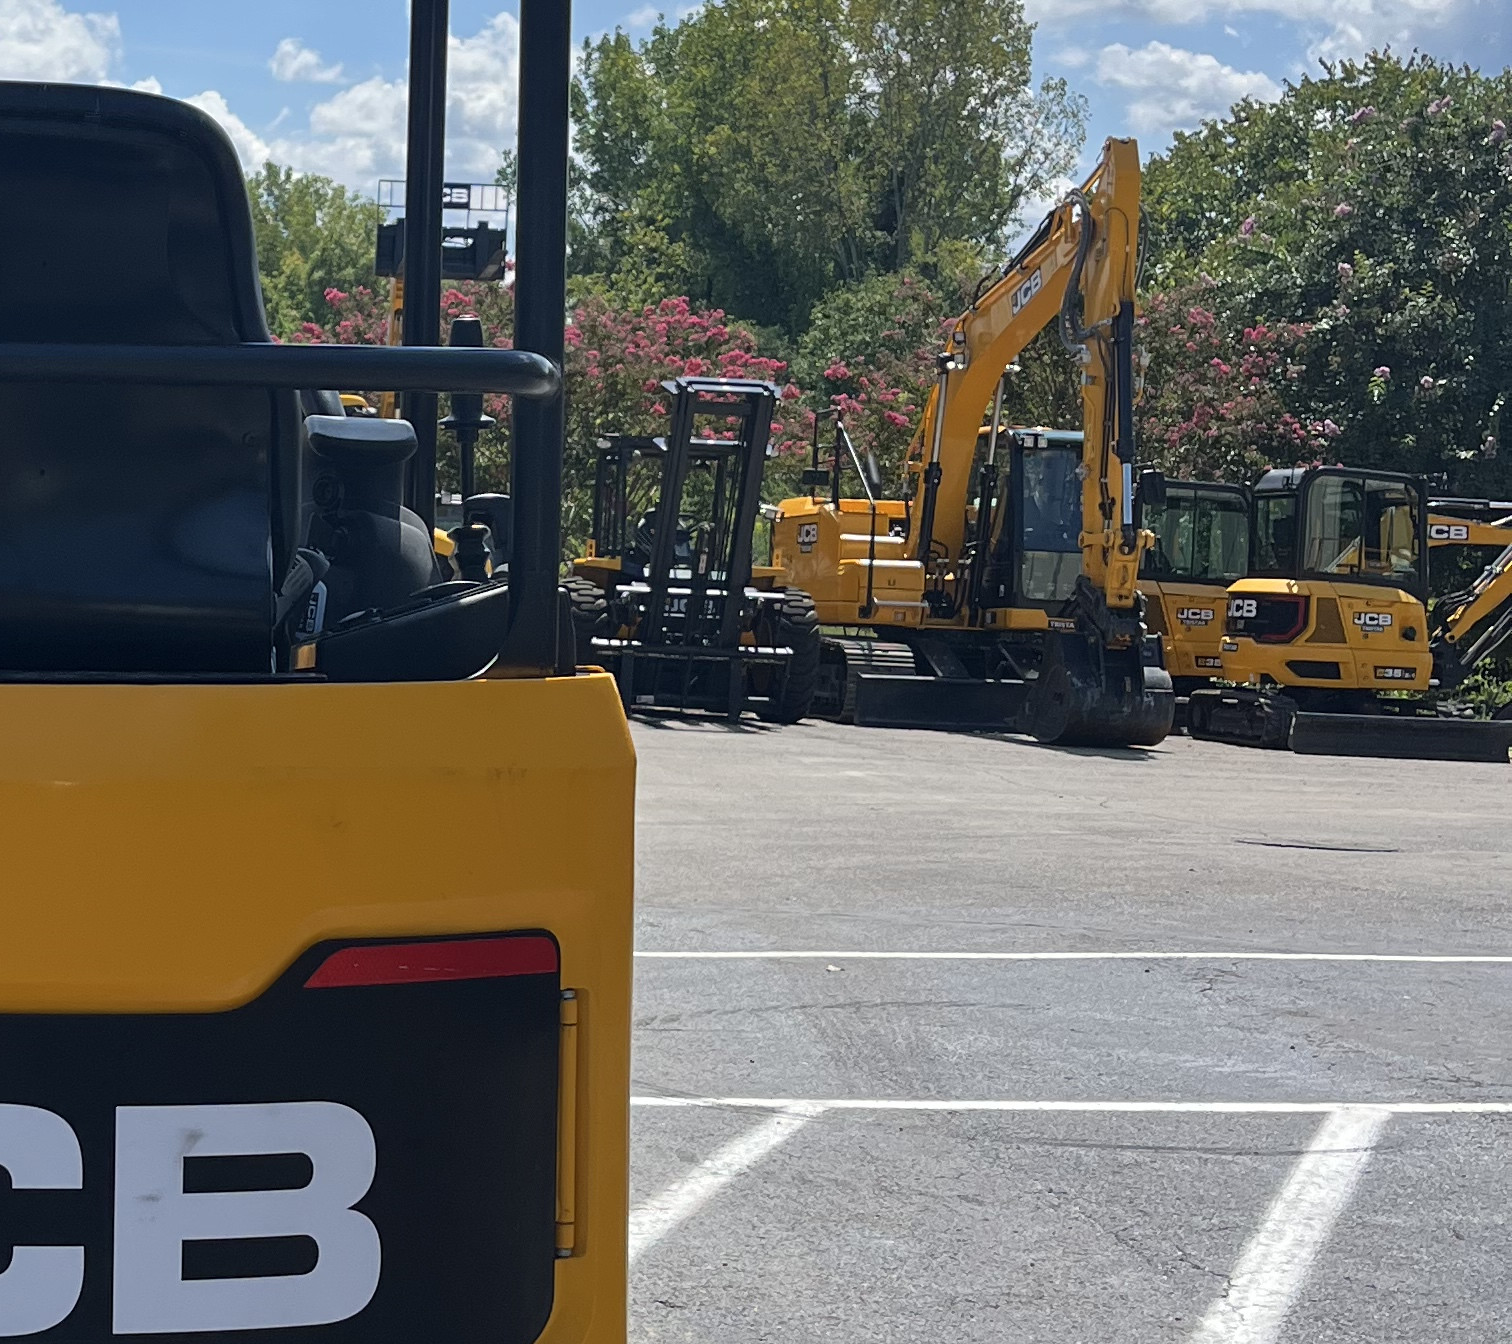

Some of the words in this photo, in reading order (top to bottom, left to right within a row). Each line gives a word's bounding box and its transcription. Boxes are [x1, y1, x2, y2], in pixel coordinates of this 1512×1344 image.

[1012, 267, 1043, 315] JCB
[797, 523, 819, 544] JCB
[1428, 524, 1468, 540] CB
[1177, 608, 1214, 620] JCB
[1227, 599, 1257, 618] JCB
[1353, 612, 1392, 625] JCB
